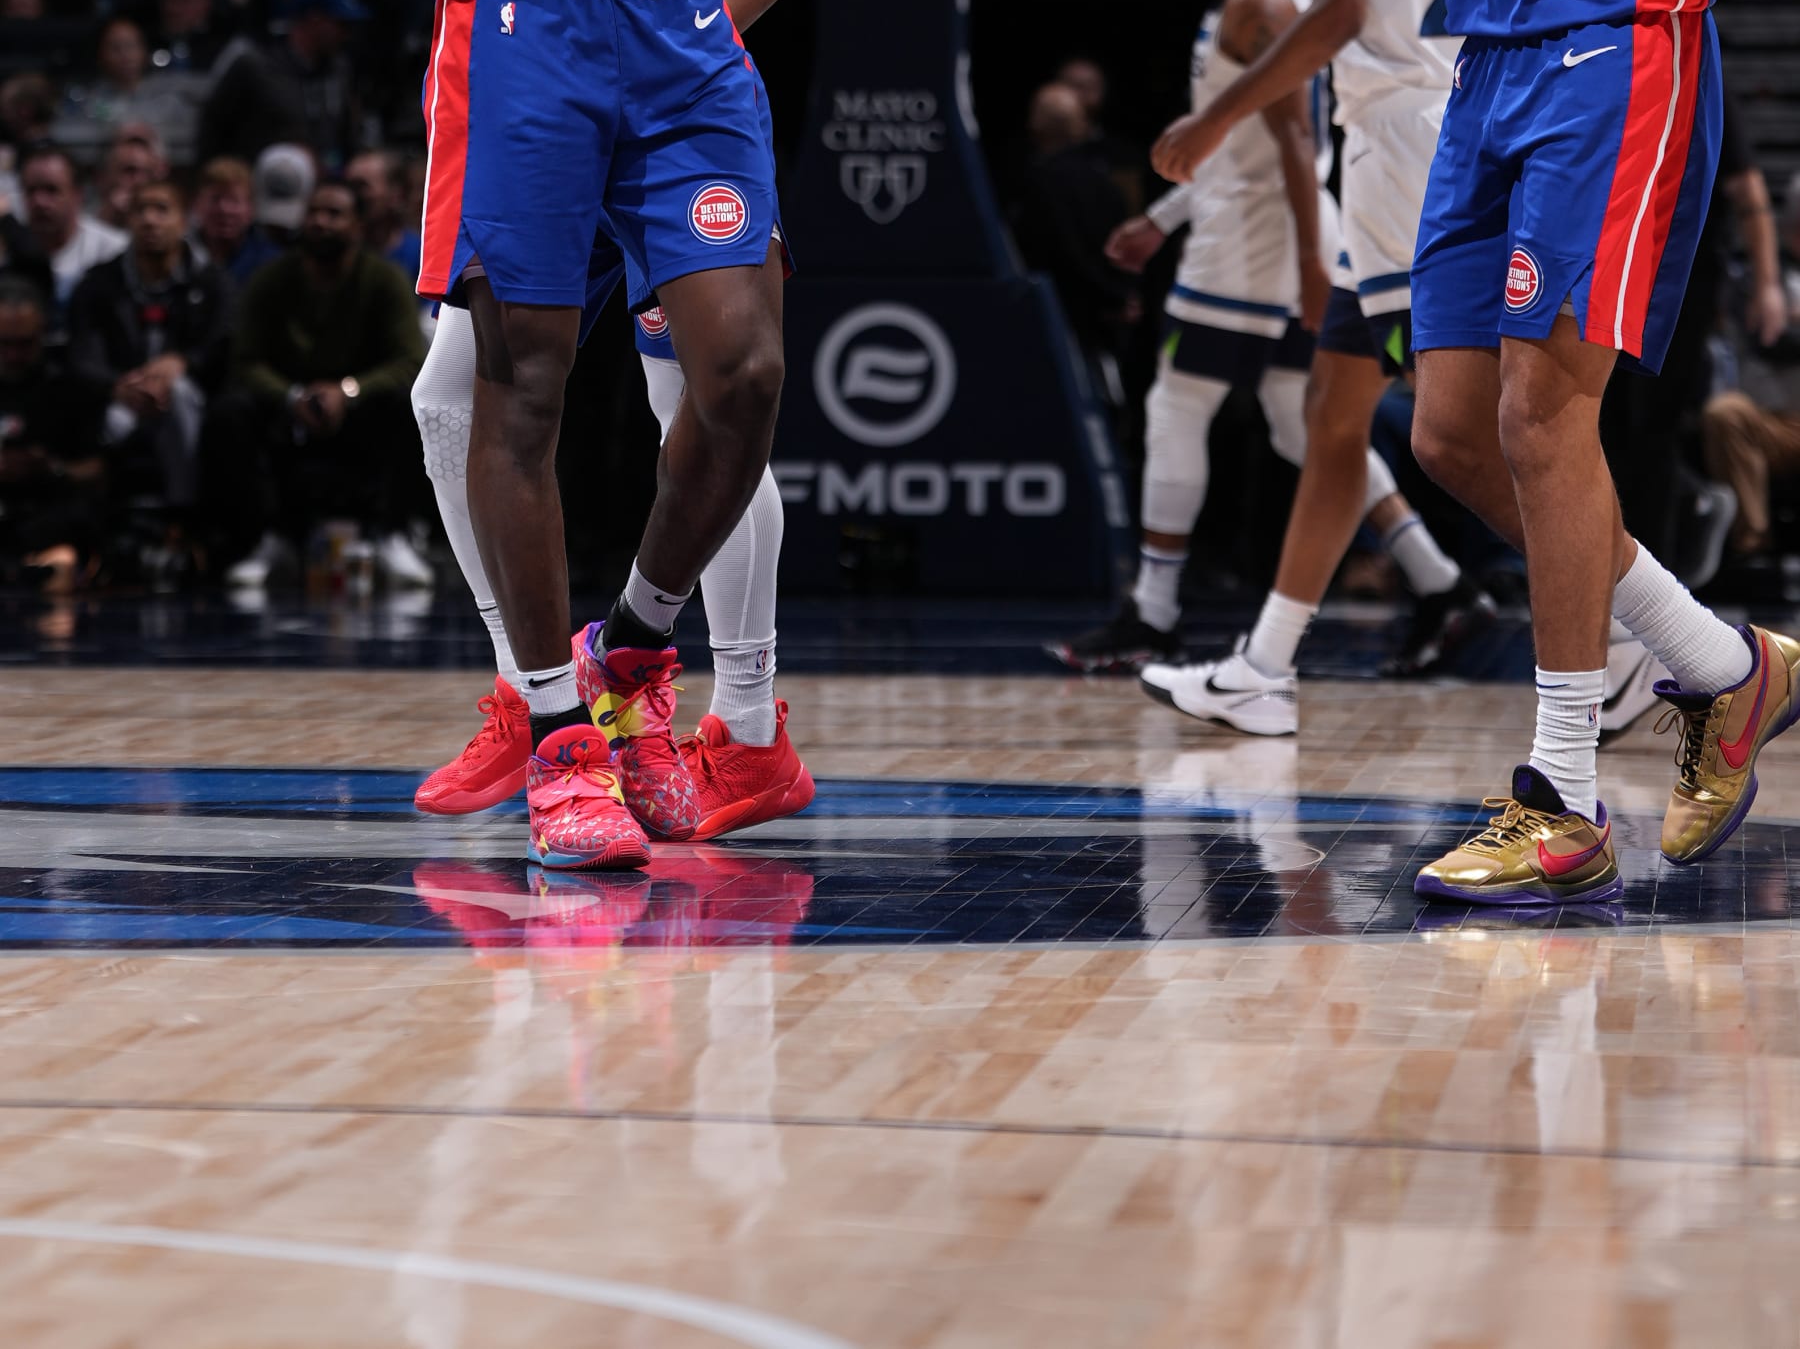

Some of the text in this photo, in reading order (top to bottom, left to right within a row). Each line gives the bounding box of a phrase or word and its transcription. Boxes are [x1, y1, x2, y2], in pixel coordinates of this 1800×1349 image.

[832, 89, 938, 122] MAYO
[821, 119, 947, 153] CLINIC
[700, 202, 737, 215] DETROIT
[701, 212, 738, 225] PISTONS
[770, 459, 1067, 518] FMOTO
